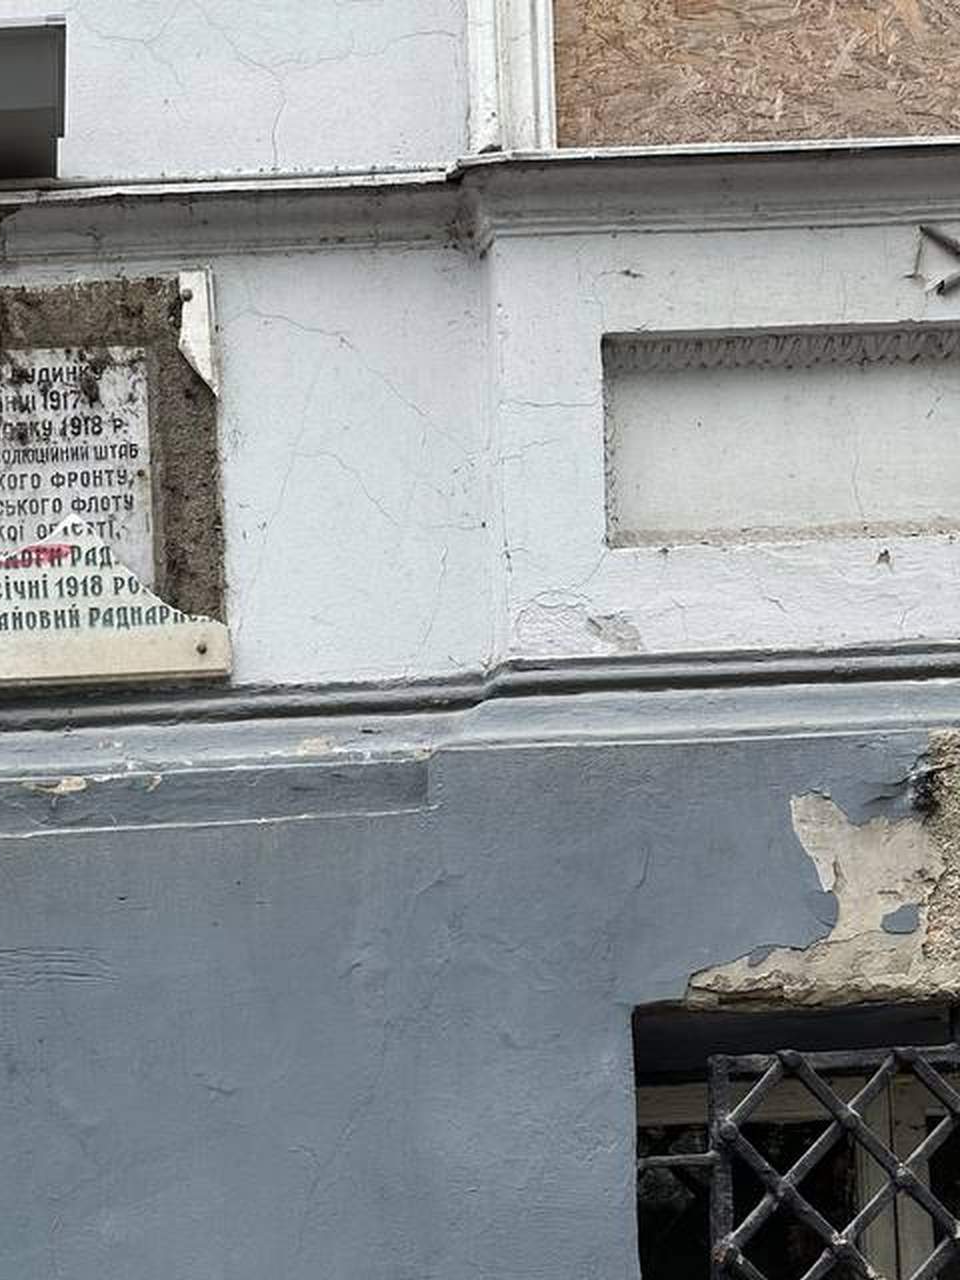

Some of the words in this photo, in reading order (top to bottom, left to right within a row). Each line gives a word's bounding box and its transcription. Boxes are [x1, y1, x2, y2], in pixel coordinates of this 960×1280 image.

[60, 414, 103, 437] 1918
[93, 443, 139, 461] ШТАБ
[50, 468, 135, 489] ФРОНТУ,
[71, 494, 135, 515] ФЛОТУ
[55, 575, 103, 599] 1918
